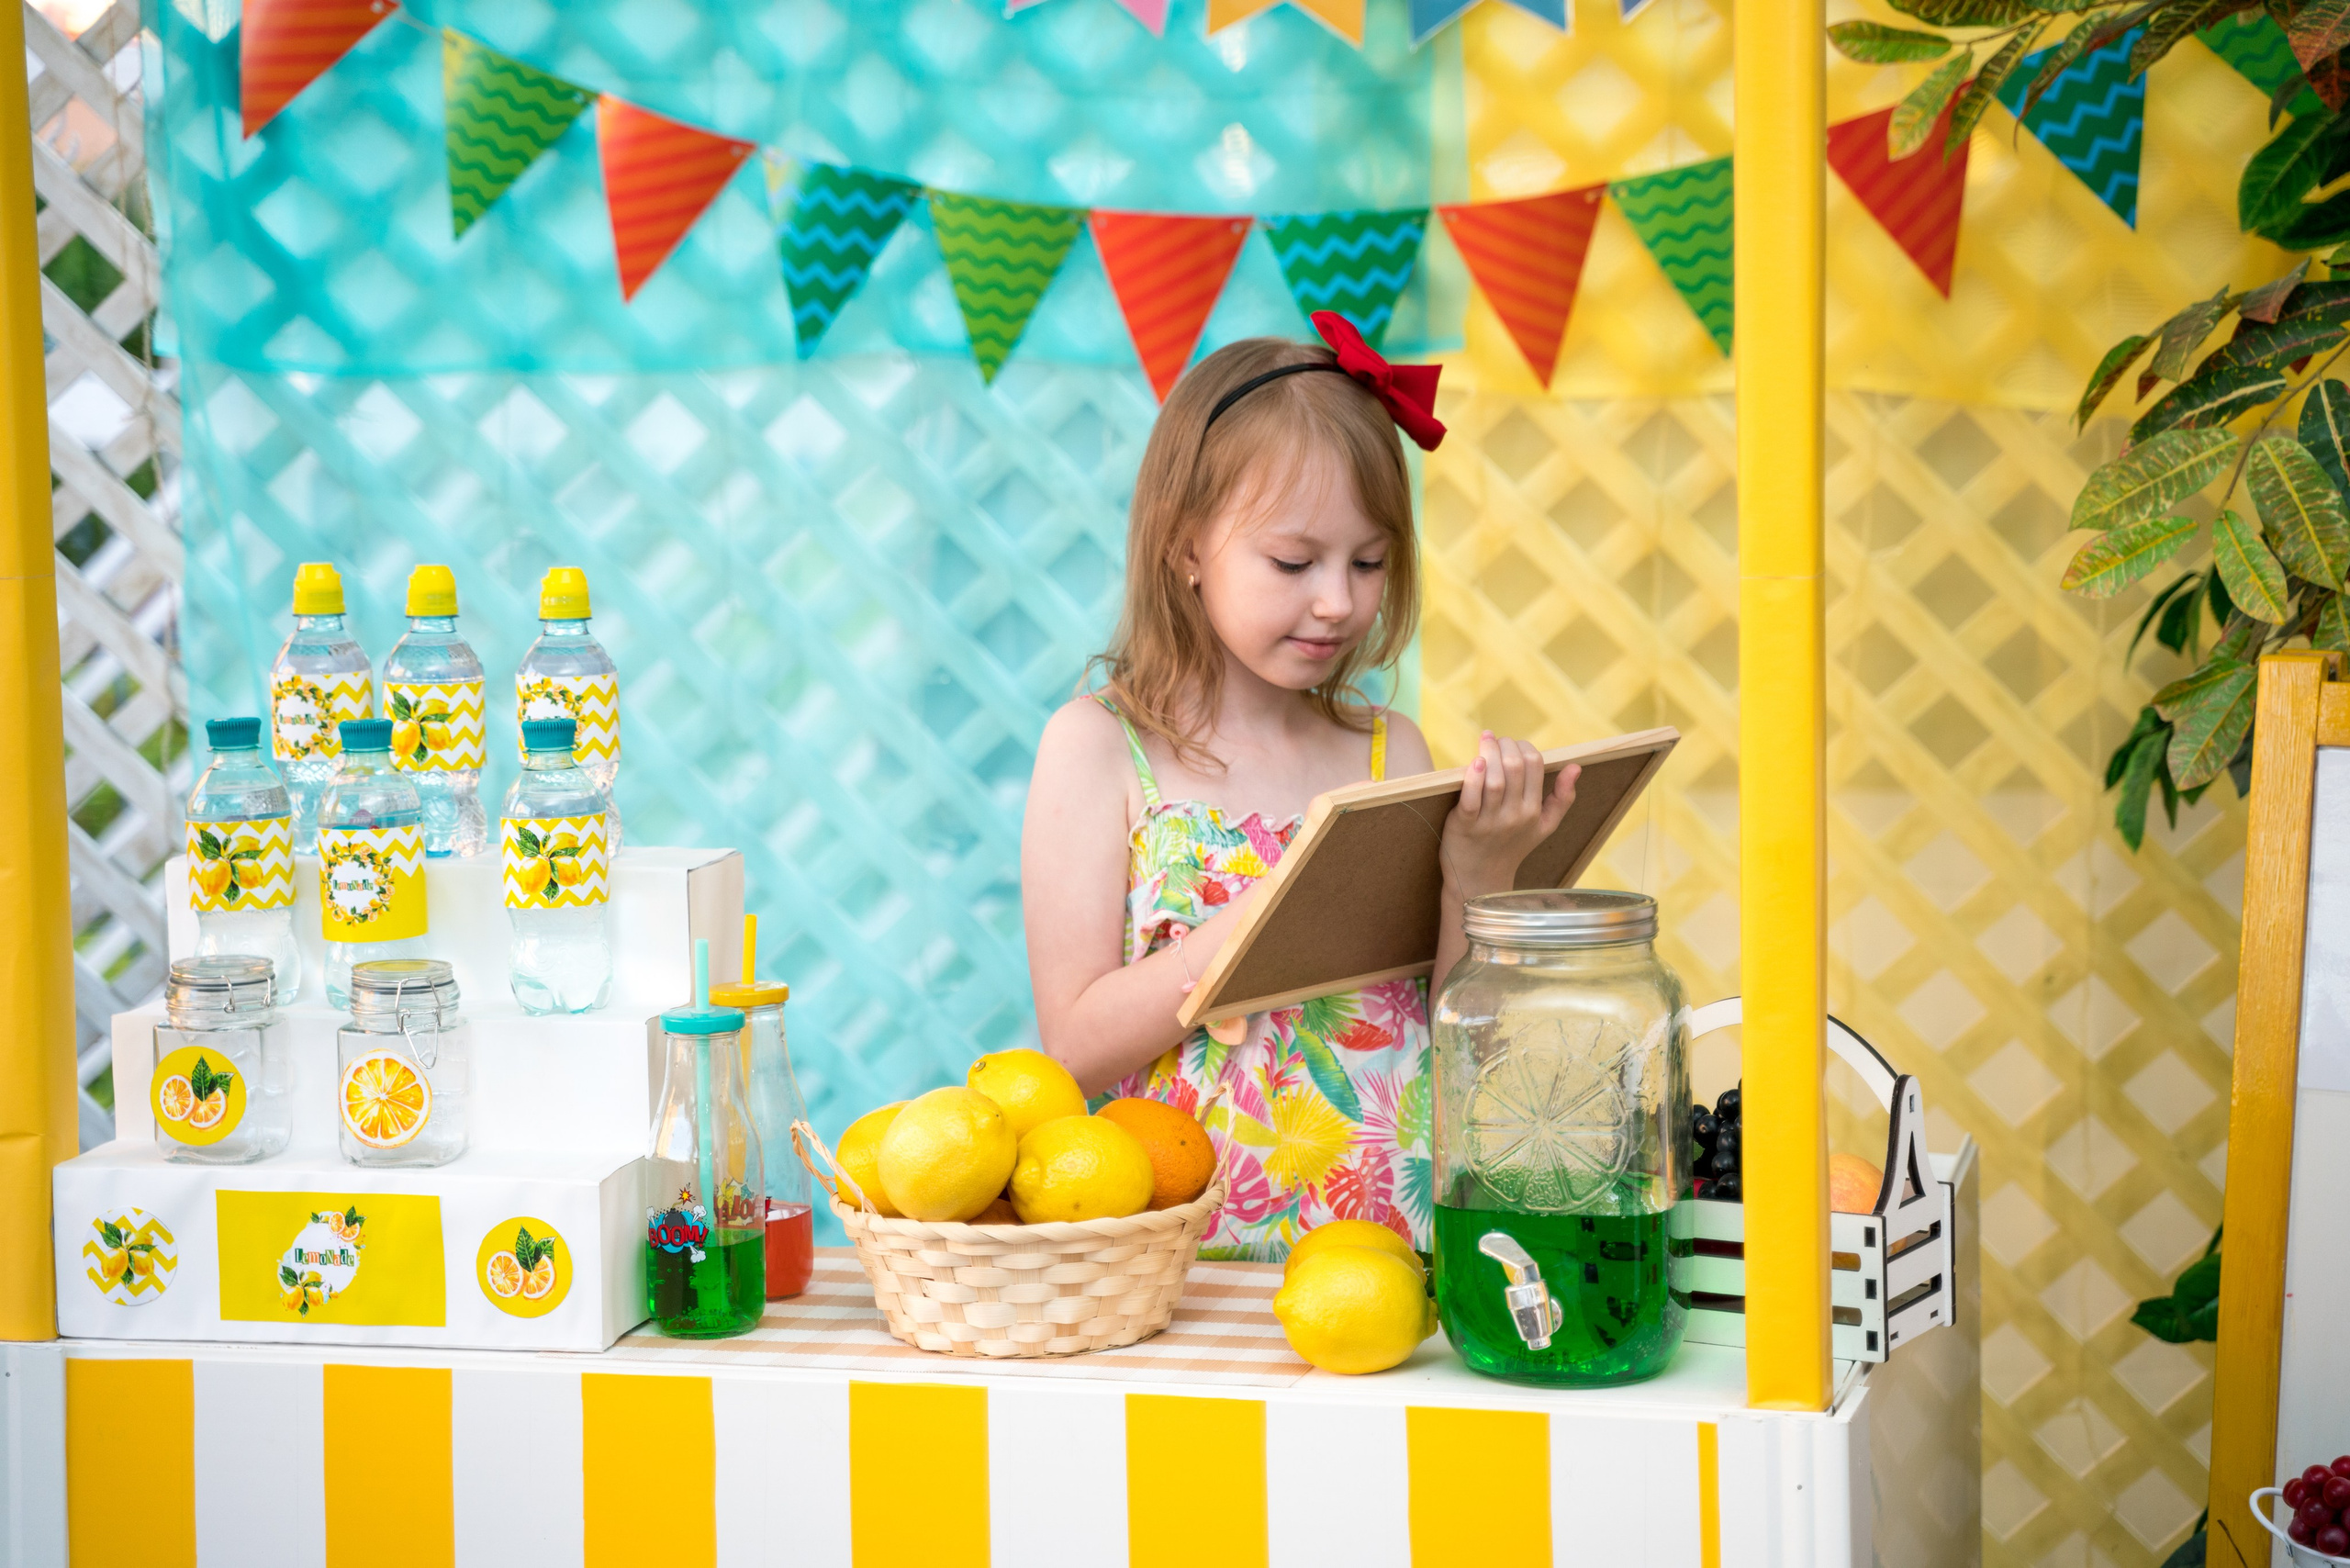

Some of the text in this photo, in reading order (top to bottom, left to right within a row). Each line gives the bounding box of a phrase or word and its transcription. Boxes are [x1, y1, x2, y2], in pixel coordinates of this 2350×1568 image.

[332, 879, 374, 891] LemoNade
[648, 1224, 710, 1249] BOOM!
[295, 1248, 354, 1266] LemoNade
